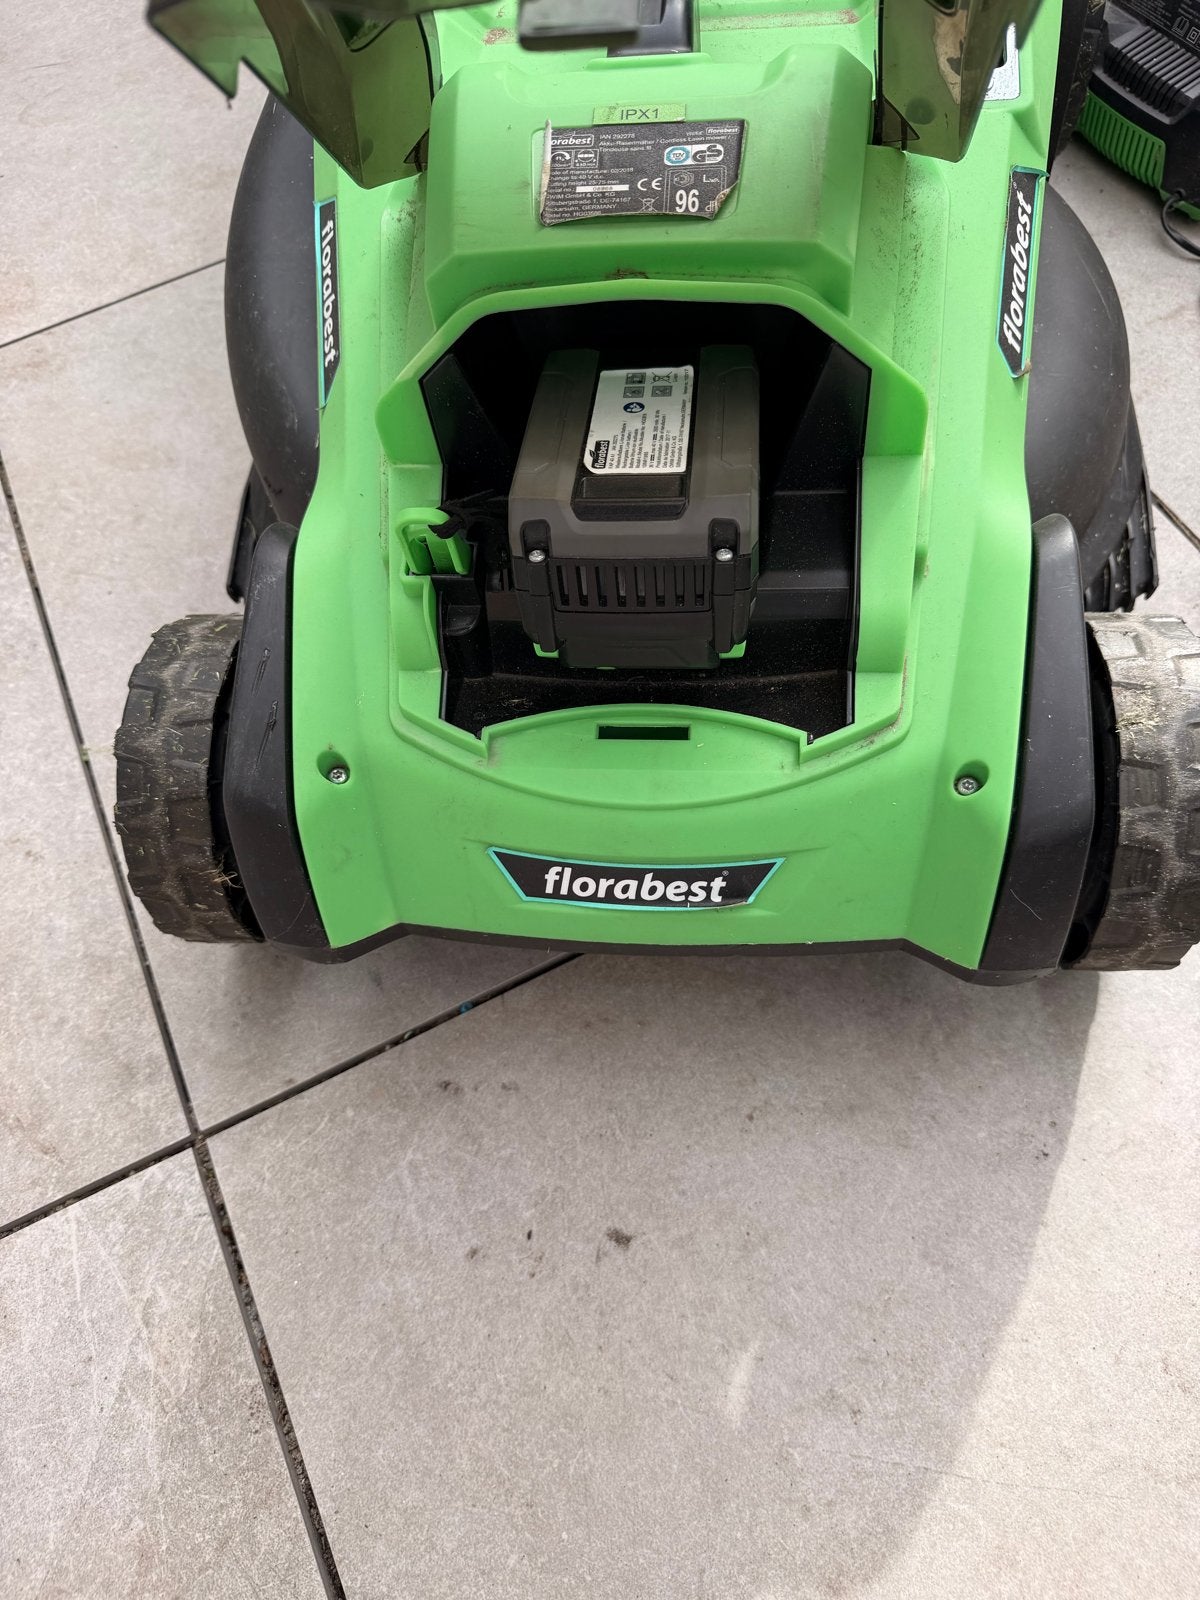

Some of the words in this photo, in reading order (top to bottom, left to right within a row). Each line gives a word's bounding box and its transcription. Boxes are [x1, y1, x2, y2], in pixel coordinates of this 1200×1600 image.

[620, 108, 660, 120] IPX1
[550, 137, 592, 146] orabest
[675, 189, 700, 213] 96
[1003, 190, 1032, 354] florabest
[322, 219, 336, 368] florabest
[593, 441, 609, 467] florabest
[544, 866, 727, 903] florabest
